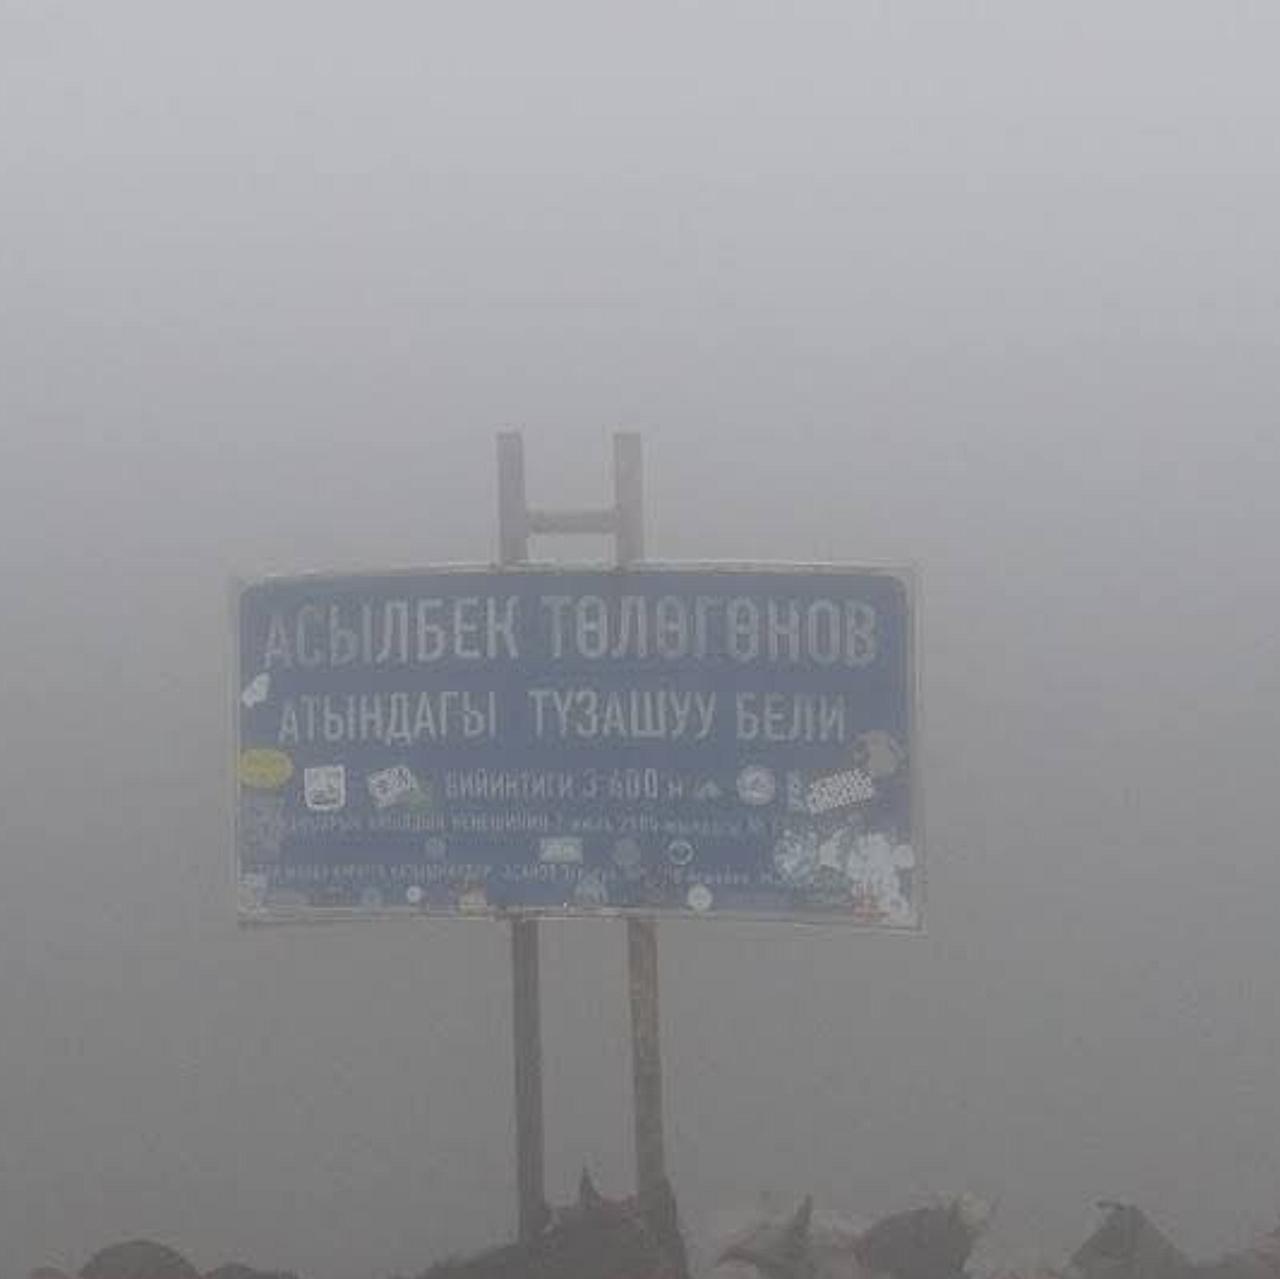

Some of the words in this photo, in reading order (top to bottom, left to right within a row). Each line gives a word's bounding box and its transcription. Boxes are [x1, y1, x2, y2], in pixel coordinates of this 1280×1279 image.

[264, 597, 521, 669] АСЫЛБЕК
[541, 594, 879, 668] ТӨЛӨГӨНОВ
[278, 691, 497, 745] АТЫНДАГЫ
[735, 695, 846, 743] БЕЛИ
